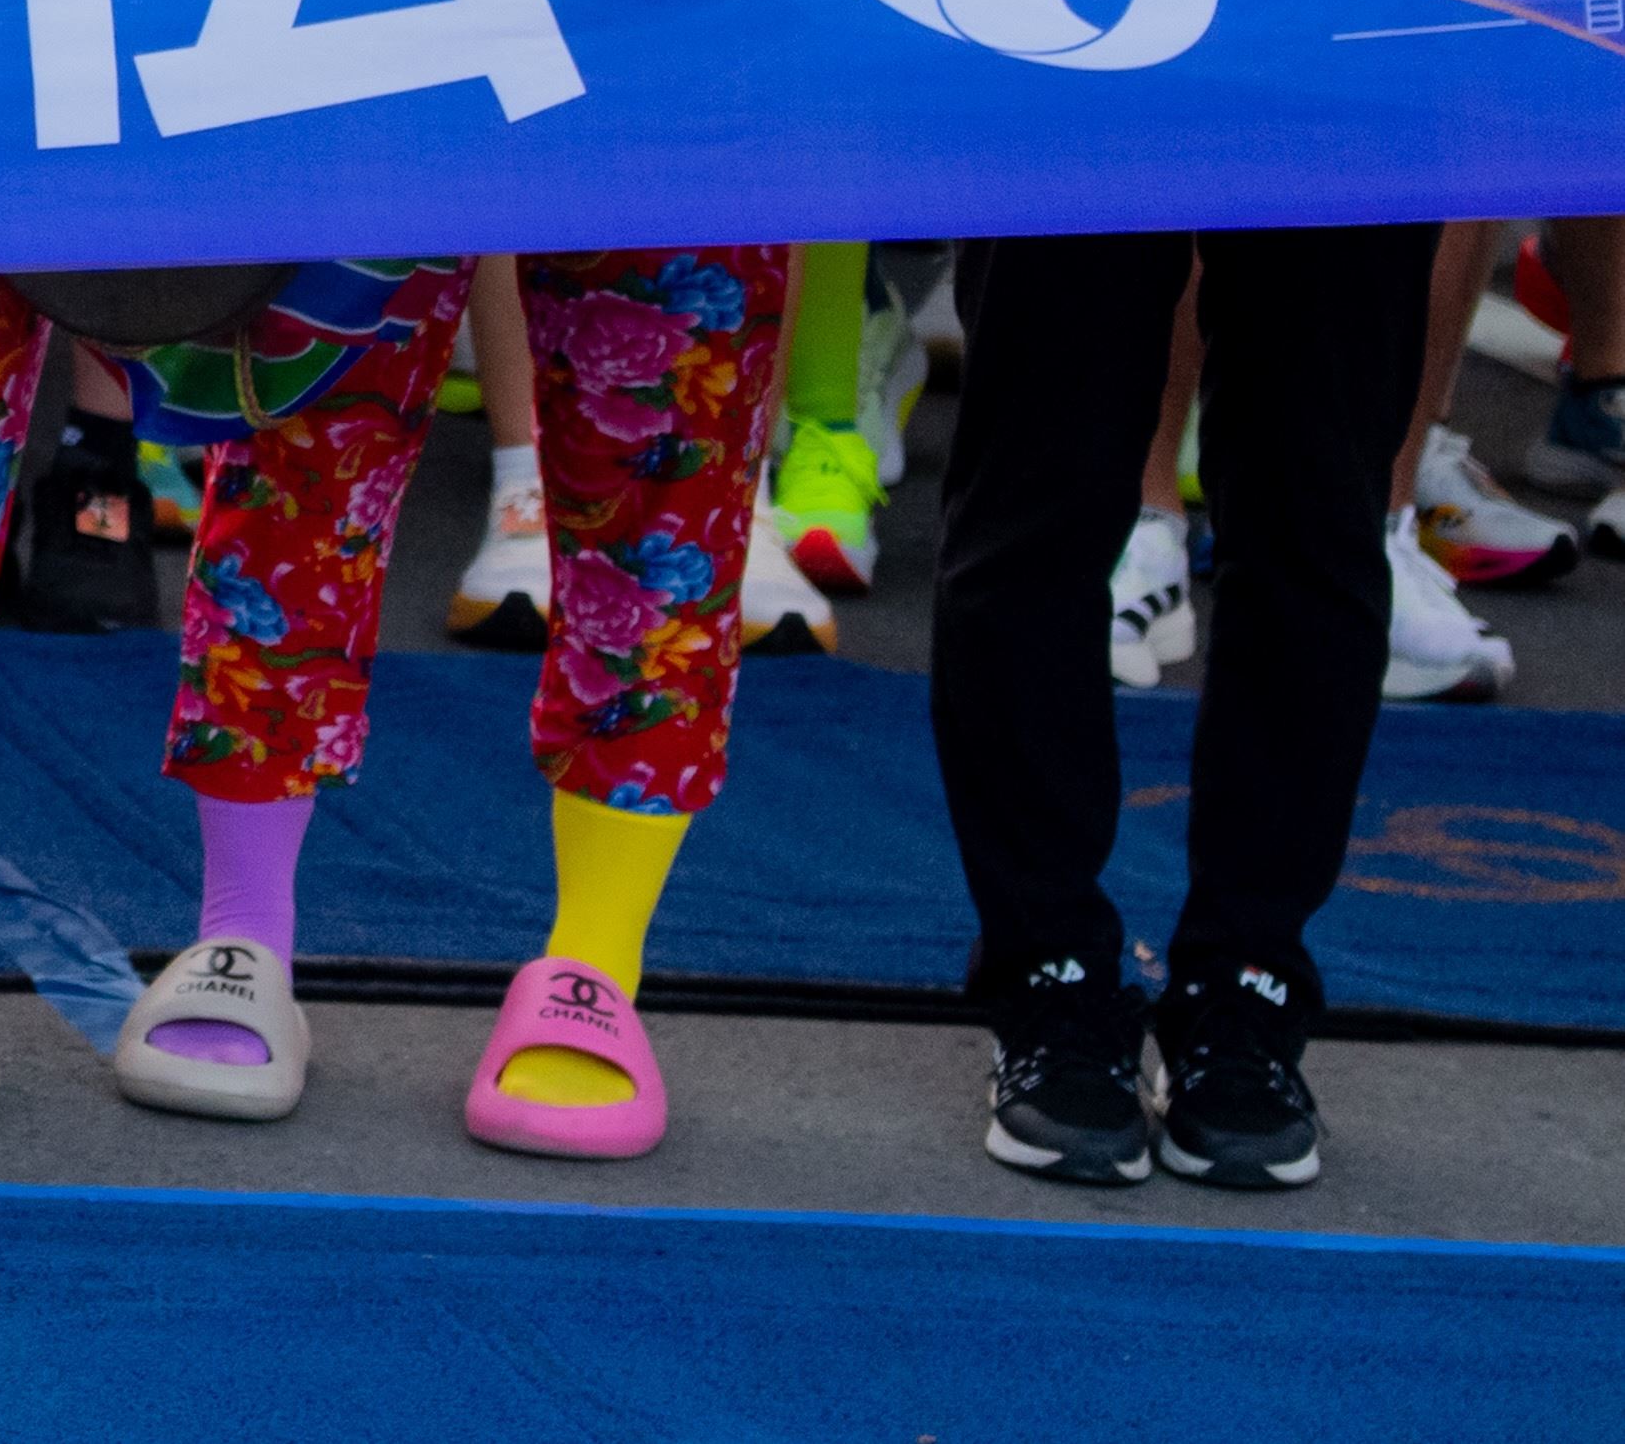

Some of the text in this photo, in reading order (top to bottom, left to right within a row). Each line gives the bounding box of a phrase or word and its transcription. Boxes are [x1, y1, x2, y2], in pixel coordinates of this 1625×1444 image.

[175, 980, 256, 1003] CHANEL
[1239, 965, 1287, 1006] FILA
[538, 1006, 621, 1037] CHANEL
